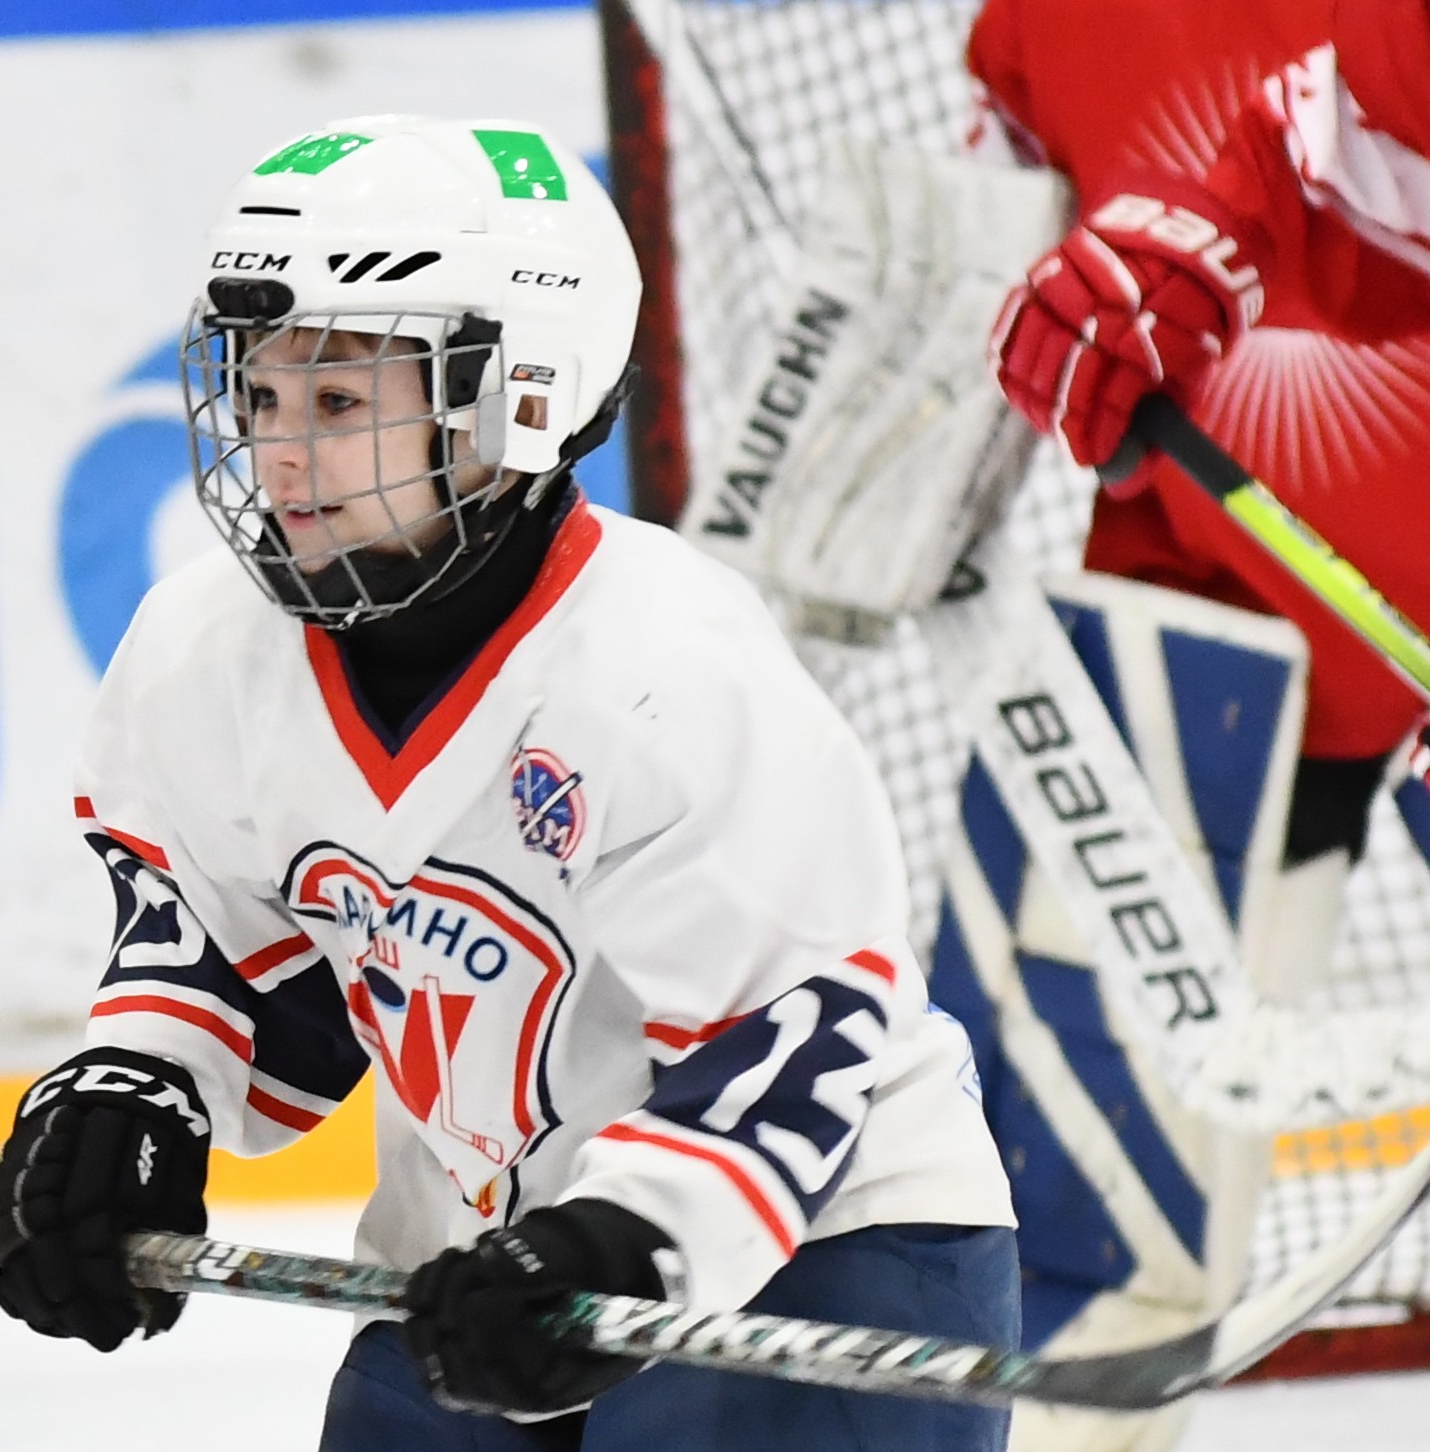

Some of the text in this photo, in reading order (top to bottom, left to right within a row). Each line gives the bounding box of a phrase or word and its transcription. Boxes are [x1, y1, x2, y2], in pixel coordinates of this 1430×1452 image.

[211, 251, 293, 272] CCM
[511, 269, 582, 290] CCM
[702, 288, 850, 539] VAUGHN
[998, 692, 1221, 1032] BAUER
[20, 1064, 211, 1138] CCM
[700, 986, 890, 1195] 13
